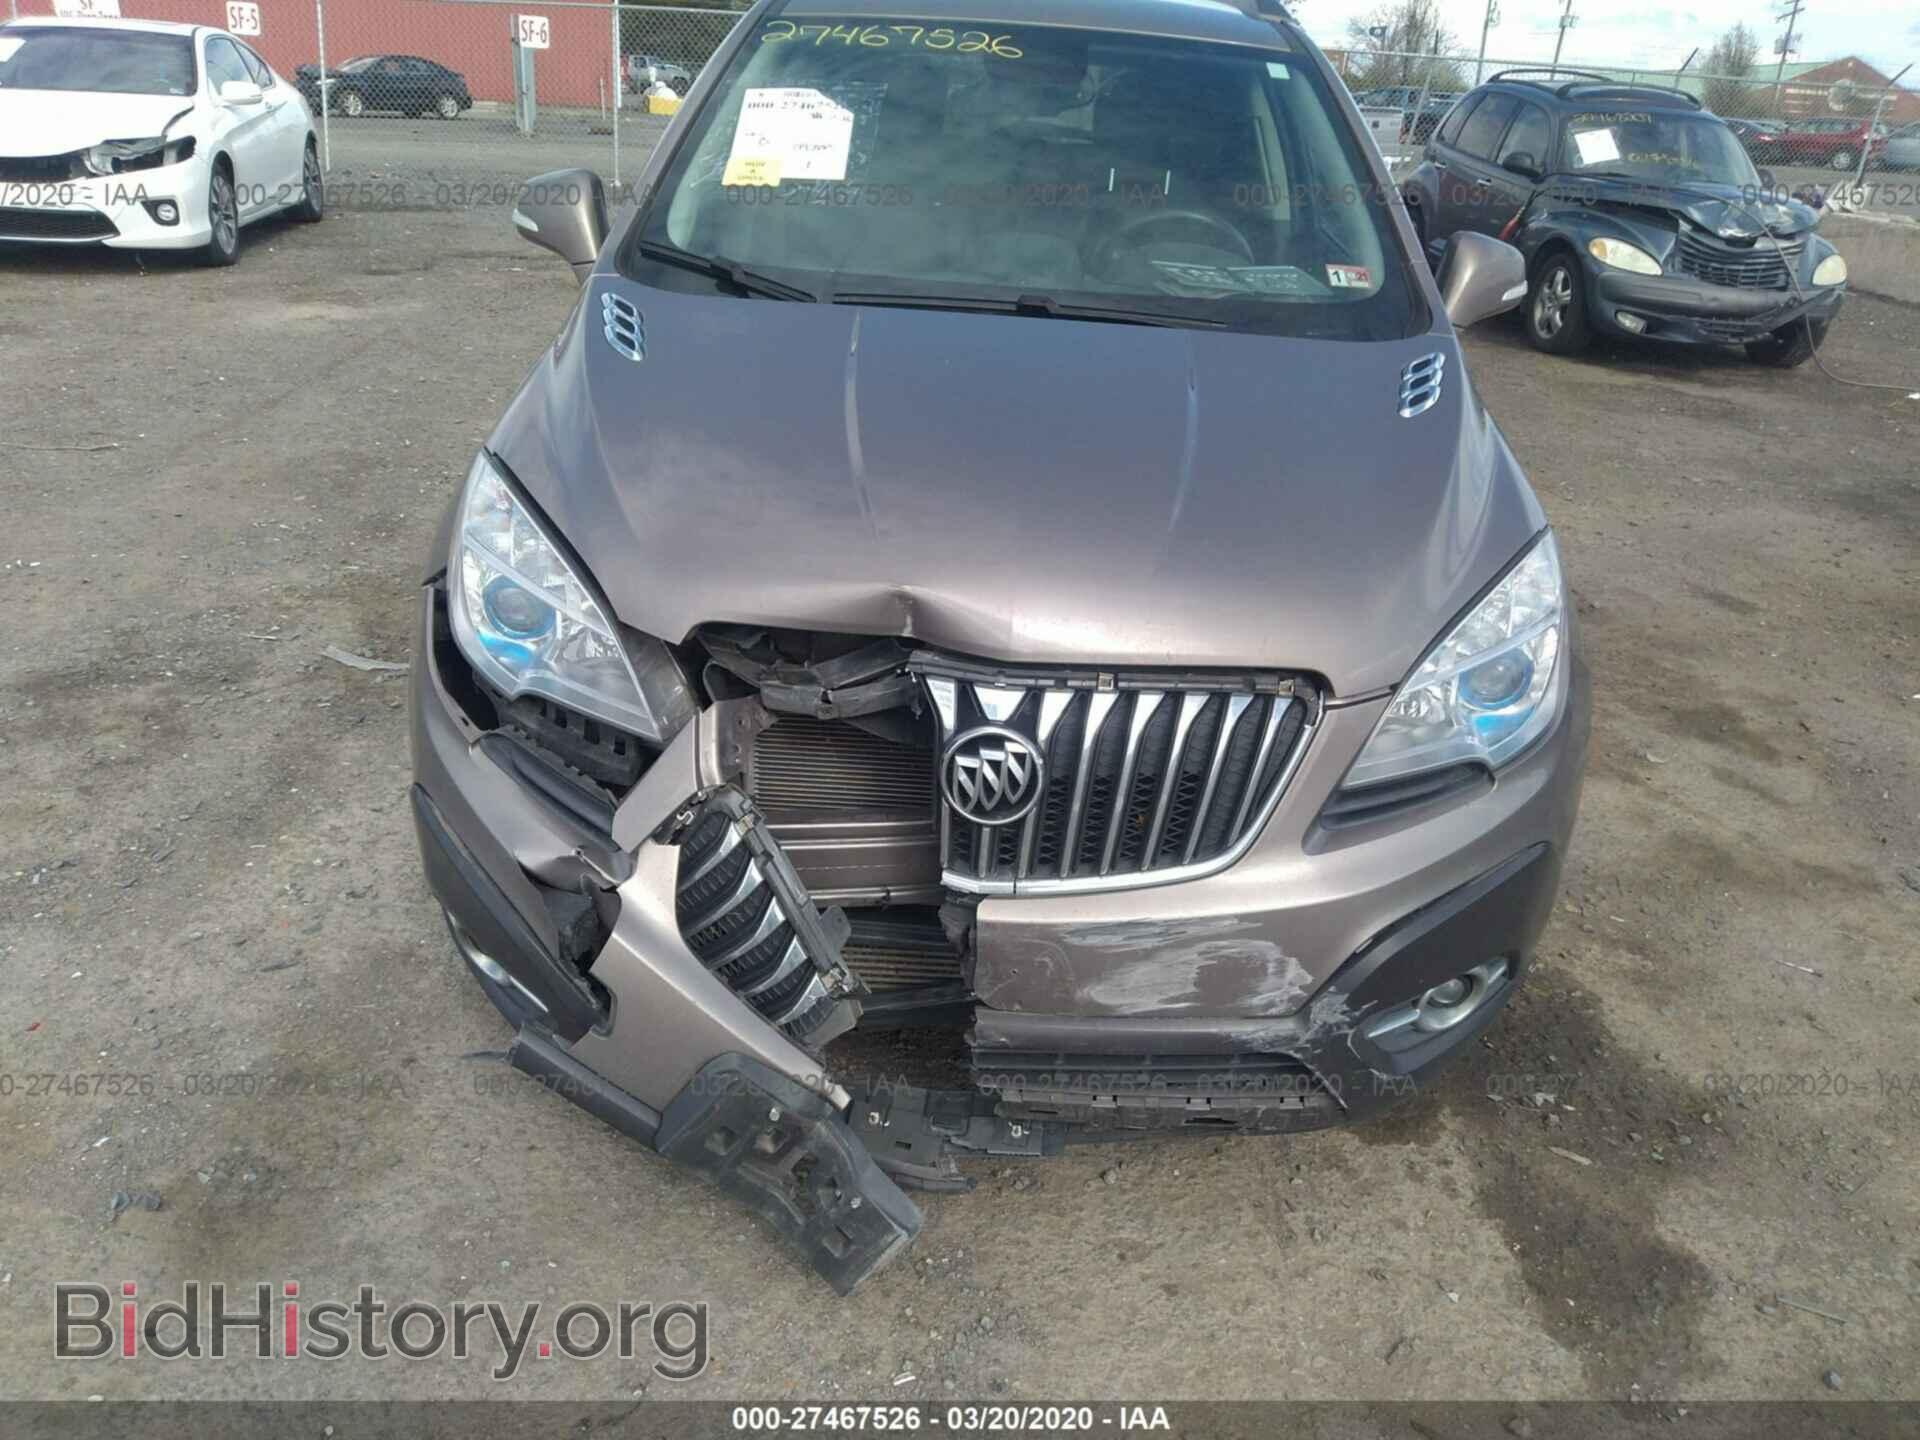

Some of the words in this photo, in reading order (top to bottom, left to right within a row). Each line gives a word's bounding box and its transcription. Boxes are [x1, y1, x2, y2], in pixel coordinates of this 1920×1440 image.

[231, 6, 258, 30] SF-5
[521, 20, 547, 43] SF-6
[761, 20, 1023, 58] 27467526
[1332, 271, 1341, 283] 1
